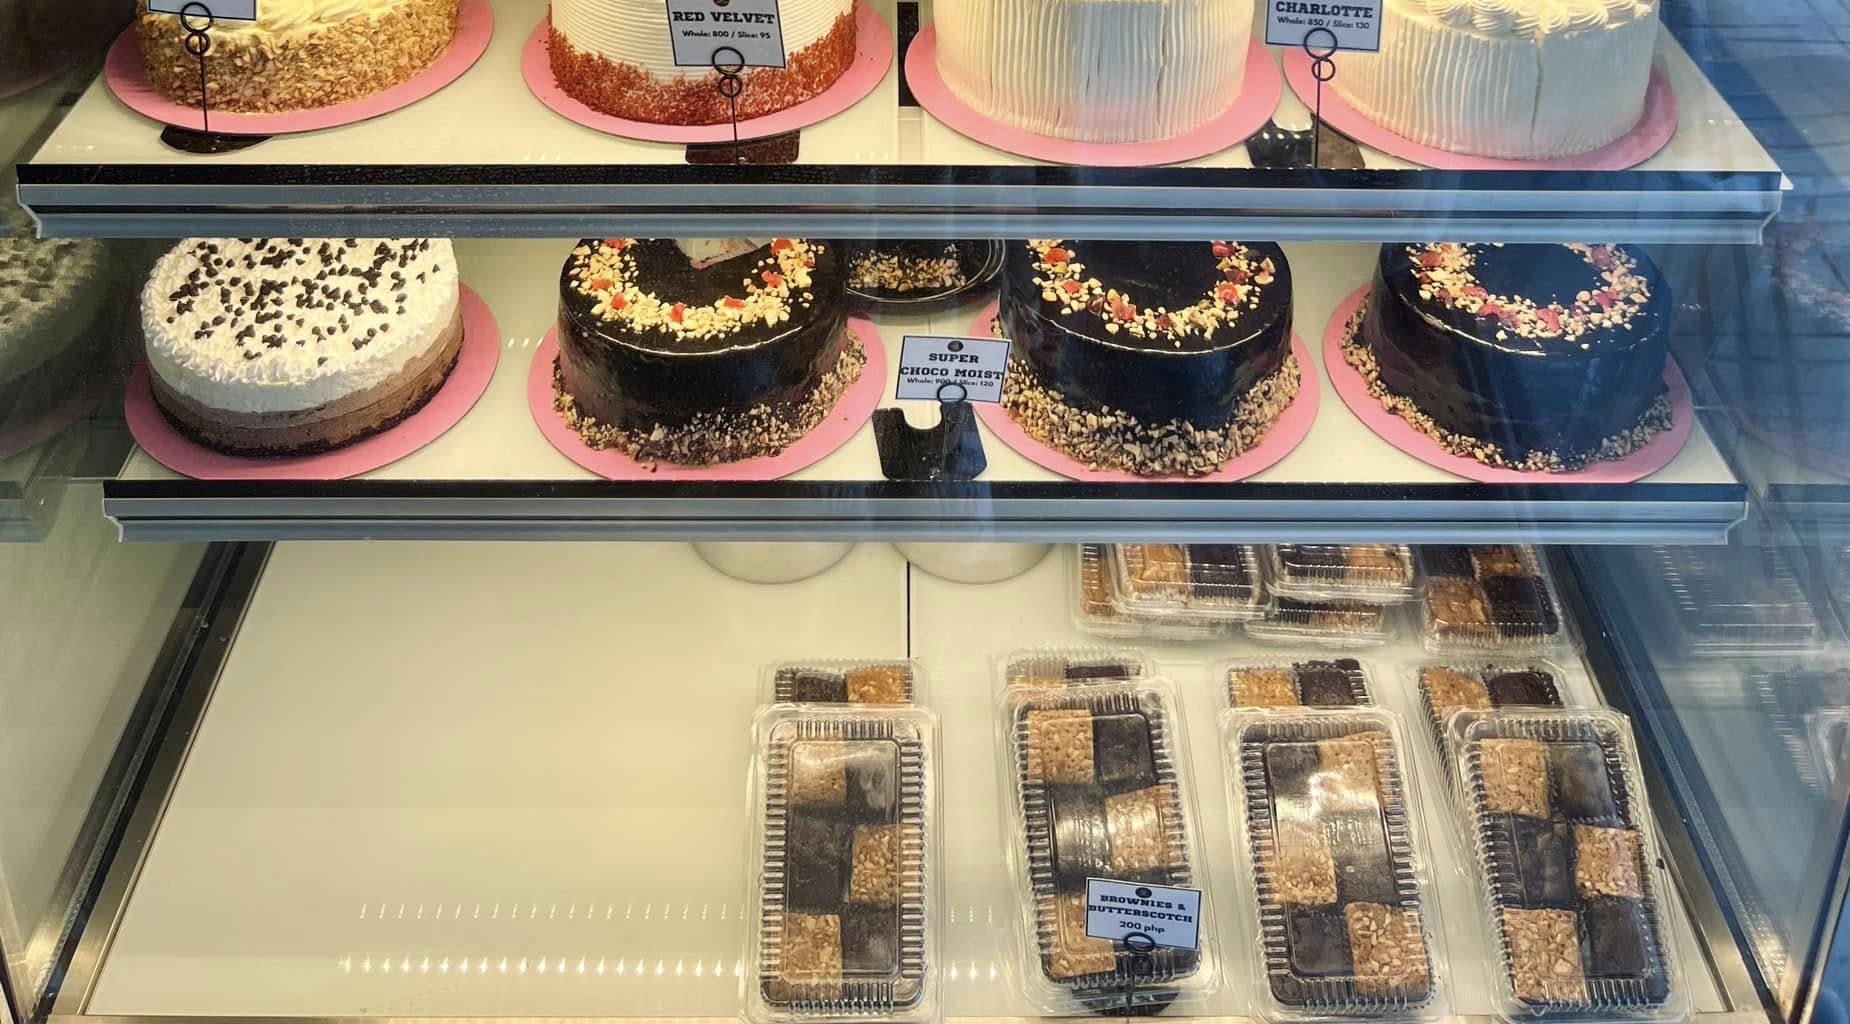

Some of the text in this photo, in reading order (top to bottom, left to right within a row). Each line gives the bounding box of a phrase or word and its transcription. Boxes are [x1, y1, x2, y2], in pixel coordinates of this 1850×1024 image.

[1276, 1, 1373, 18] CHARLOTTE
[672, 11, 775, 24] RED VELVET
[1277, 16, 1305, 25] Whole:
[1326, 19, 1331, 27] /
[1333, 20, 1353, 28] Slice:
[738, 31, 758, 39] Slice:
[929, 353, 979, 363] SUPER
[901, 366, 1004, 380] CHOCO MOIST
[1100, 894, 1172, 909] BROWNIES
[1088, 905, 1192, 923] BUTTERSCOTCH
[1120, 920, 1165, 934] 200 php
